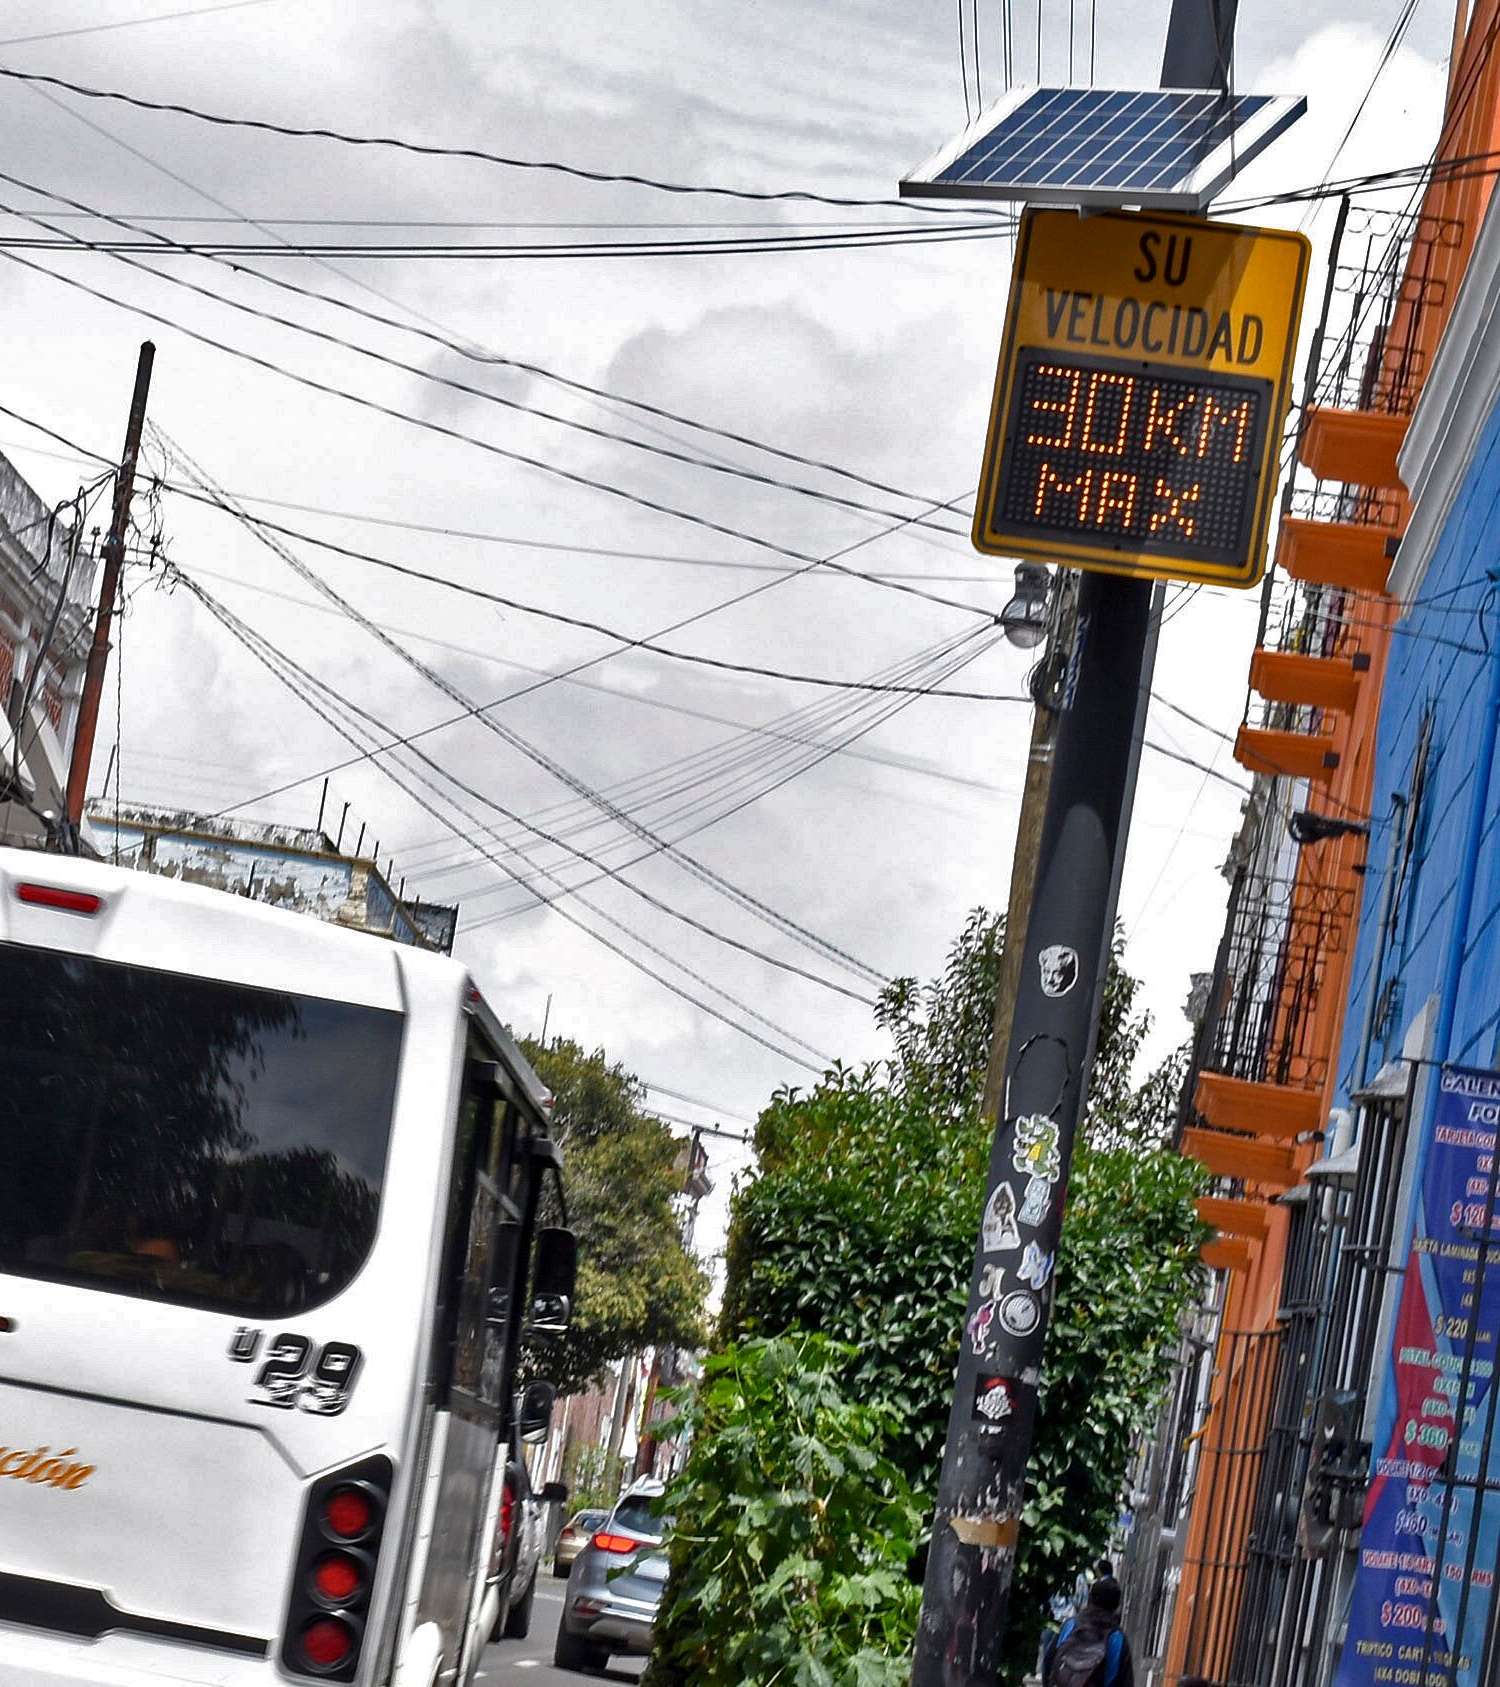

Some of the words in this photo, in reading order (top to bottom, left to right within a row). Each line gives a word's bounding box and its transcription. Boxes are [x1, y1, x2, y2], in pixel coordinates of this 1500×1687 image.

[1133, 231, 1193, 287] SU
[1042, 288, 1264, 366] VELOCIDAD
[1034, 462, 1200, 537] MAX
[1446, 1317, 1469, 1340] 220
[252, 1333, 366, 1417] 29
[1405, 1419, 1418, 1446] $
[1382, 1600, 1393, 1628] $
[1393, 1602, 1422, 1630] 200
